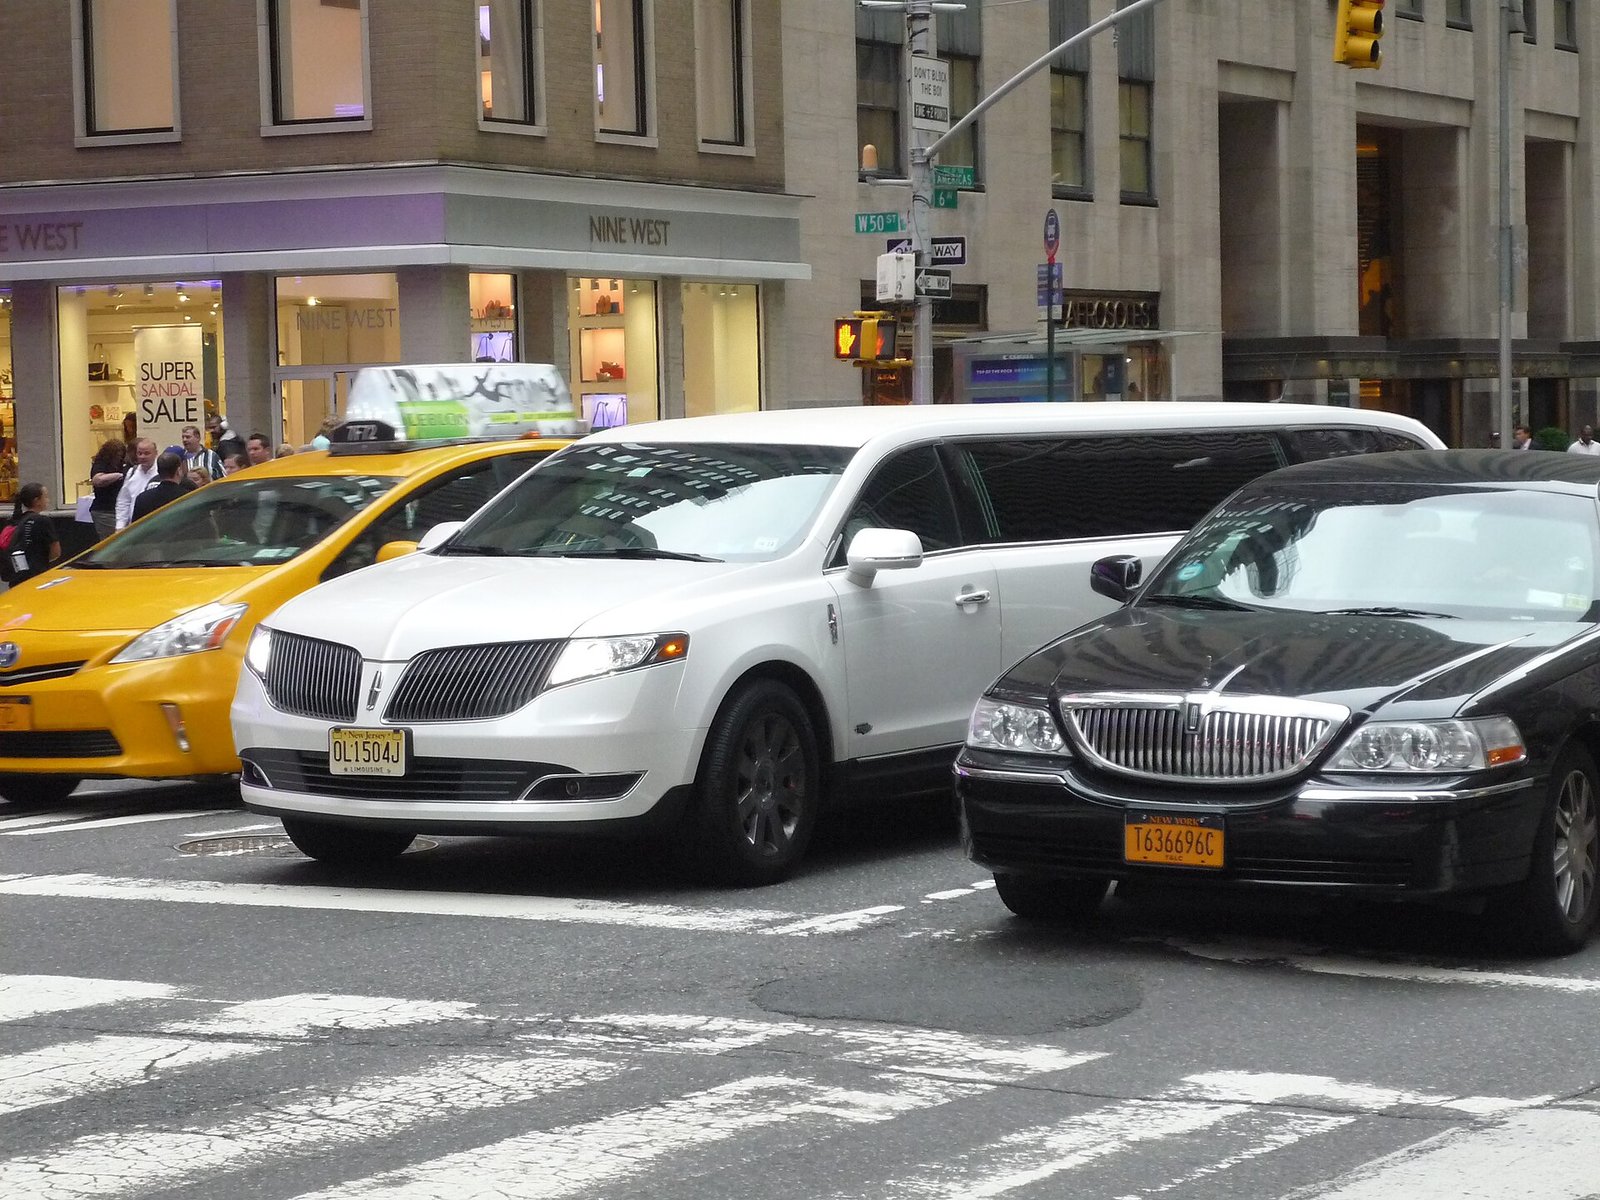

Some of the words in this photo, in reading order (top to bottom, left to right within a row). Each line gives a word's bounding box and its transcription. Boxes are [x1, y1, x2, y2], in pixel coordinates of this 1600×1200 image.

[931, 69, 947, 83] BLOCK
[921, 82, 932, 95] THE
[932, 84, 943, 97] BOX
[939, 191, 945, 206] 6
[589, 215, 626, 244] NINE
[629, 217, 671, 247] WEST
[858, 215, 868, 232] W
[869, 214, 885, 232] 50
[886, 214, 897, 224] ST
[14, 221, 84, 251] WEST
[934, 244, 960, 257] WAY
[919, 276, 931, 288] ONE
[936, 278, 950, 289] WAY
[296, 305, 340, 331] NINE
[343, 303, 396, 328] WEST
[140, 361, 197, 382] SUPER
[141, 382, 197, 398] SANDAL
[142, 397, 198, 424] SALE
[348, 731, 363, 739] New
[365, 731, 386, 740] Jersey
[1175, 816, 1199, 827] YORK
[1134, 826, 1214, 856] T636696C
